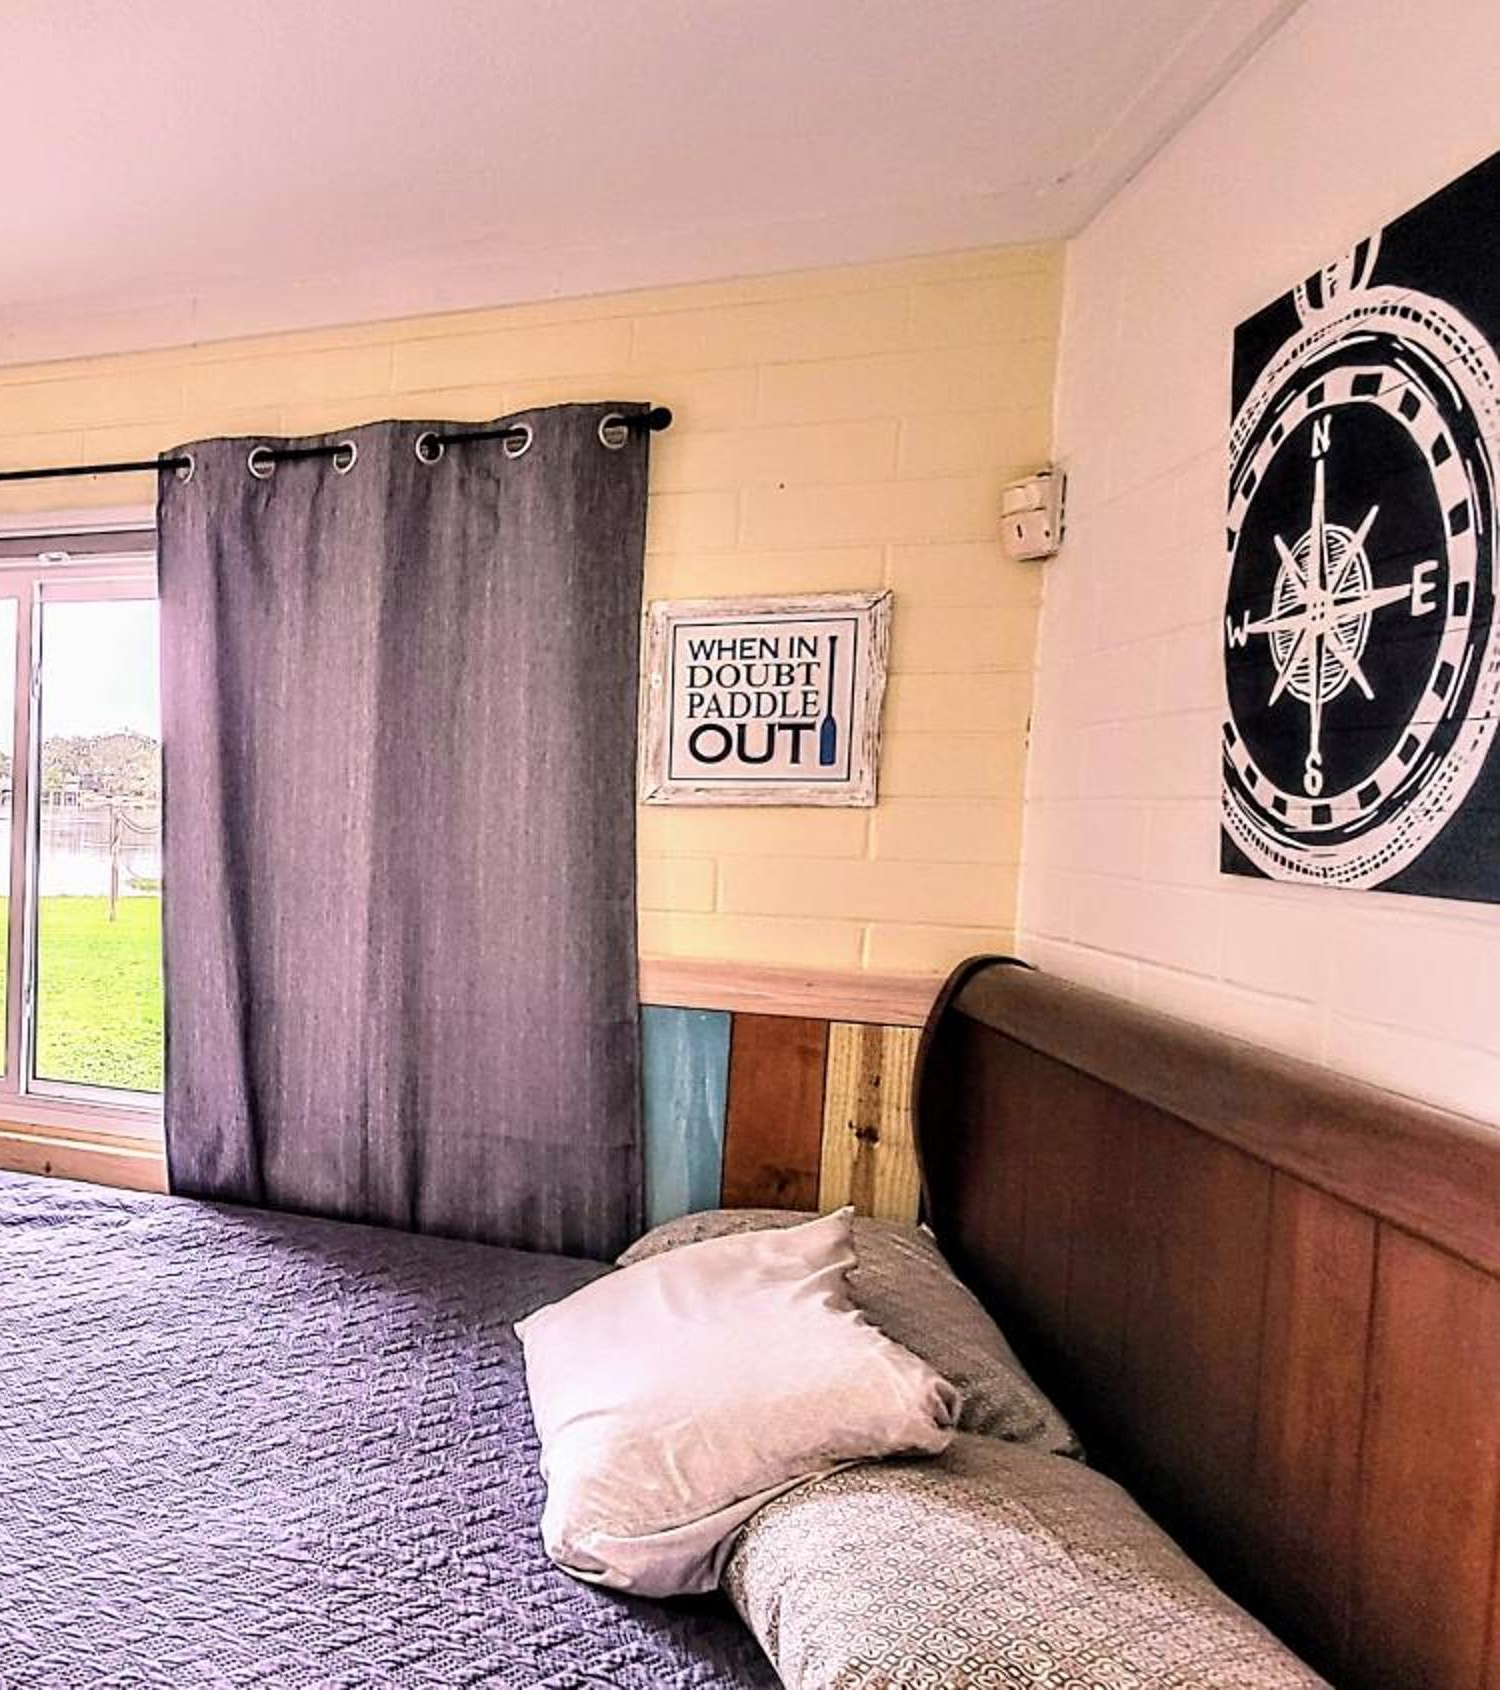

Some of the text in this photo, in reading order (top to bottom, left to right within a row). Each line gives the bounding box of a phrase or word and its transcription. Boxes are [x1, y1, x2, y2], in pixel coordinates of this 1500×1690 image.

[1311, 414, 1332, 458] N
[1411, 559, 1439, 616] E
[688, 635, 818, 661] WHEN IN
[1226, 610, 1250, 648] W
[685, 661, 821, 689] DOUBT
[686, 690, 821, 719] PADDLE
[688, 721, 816, 764] OUT
